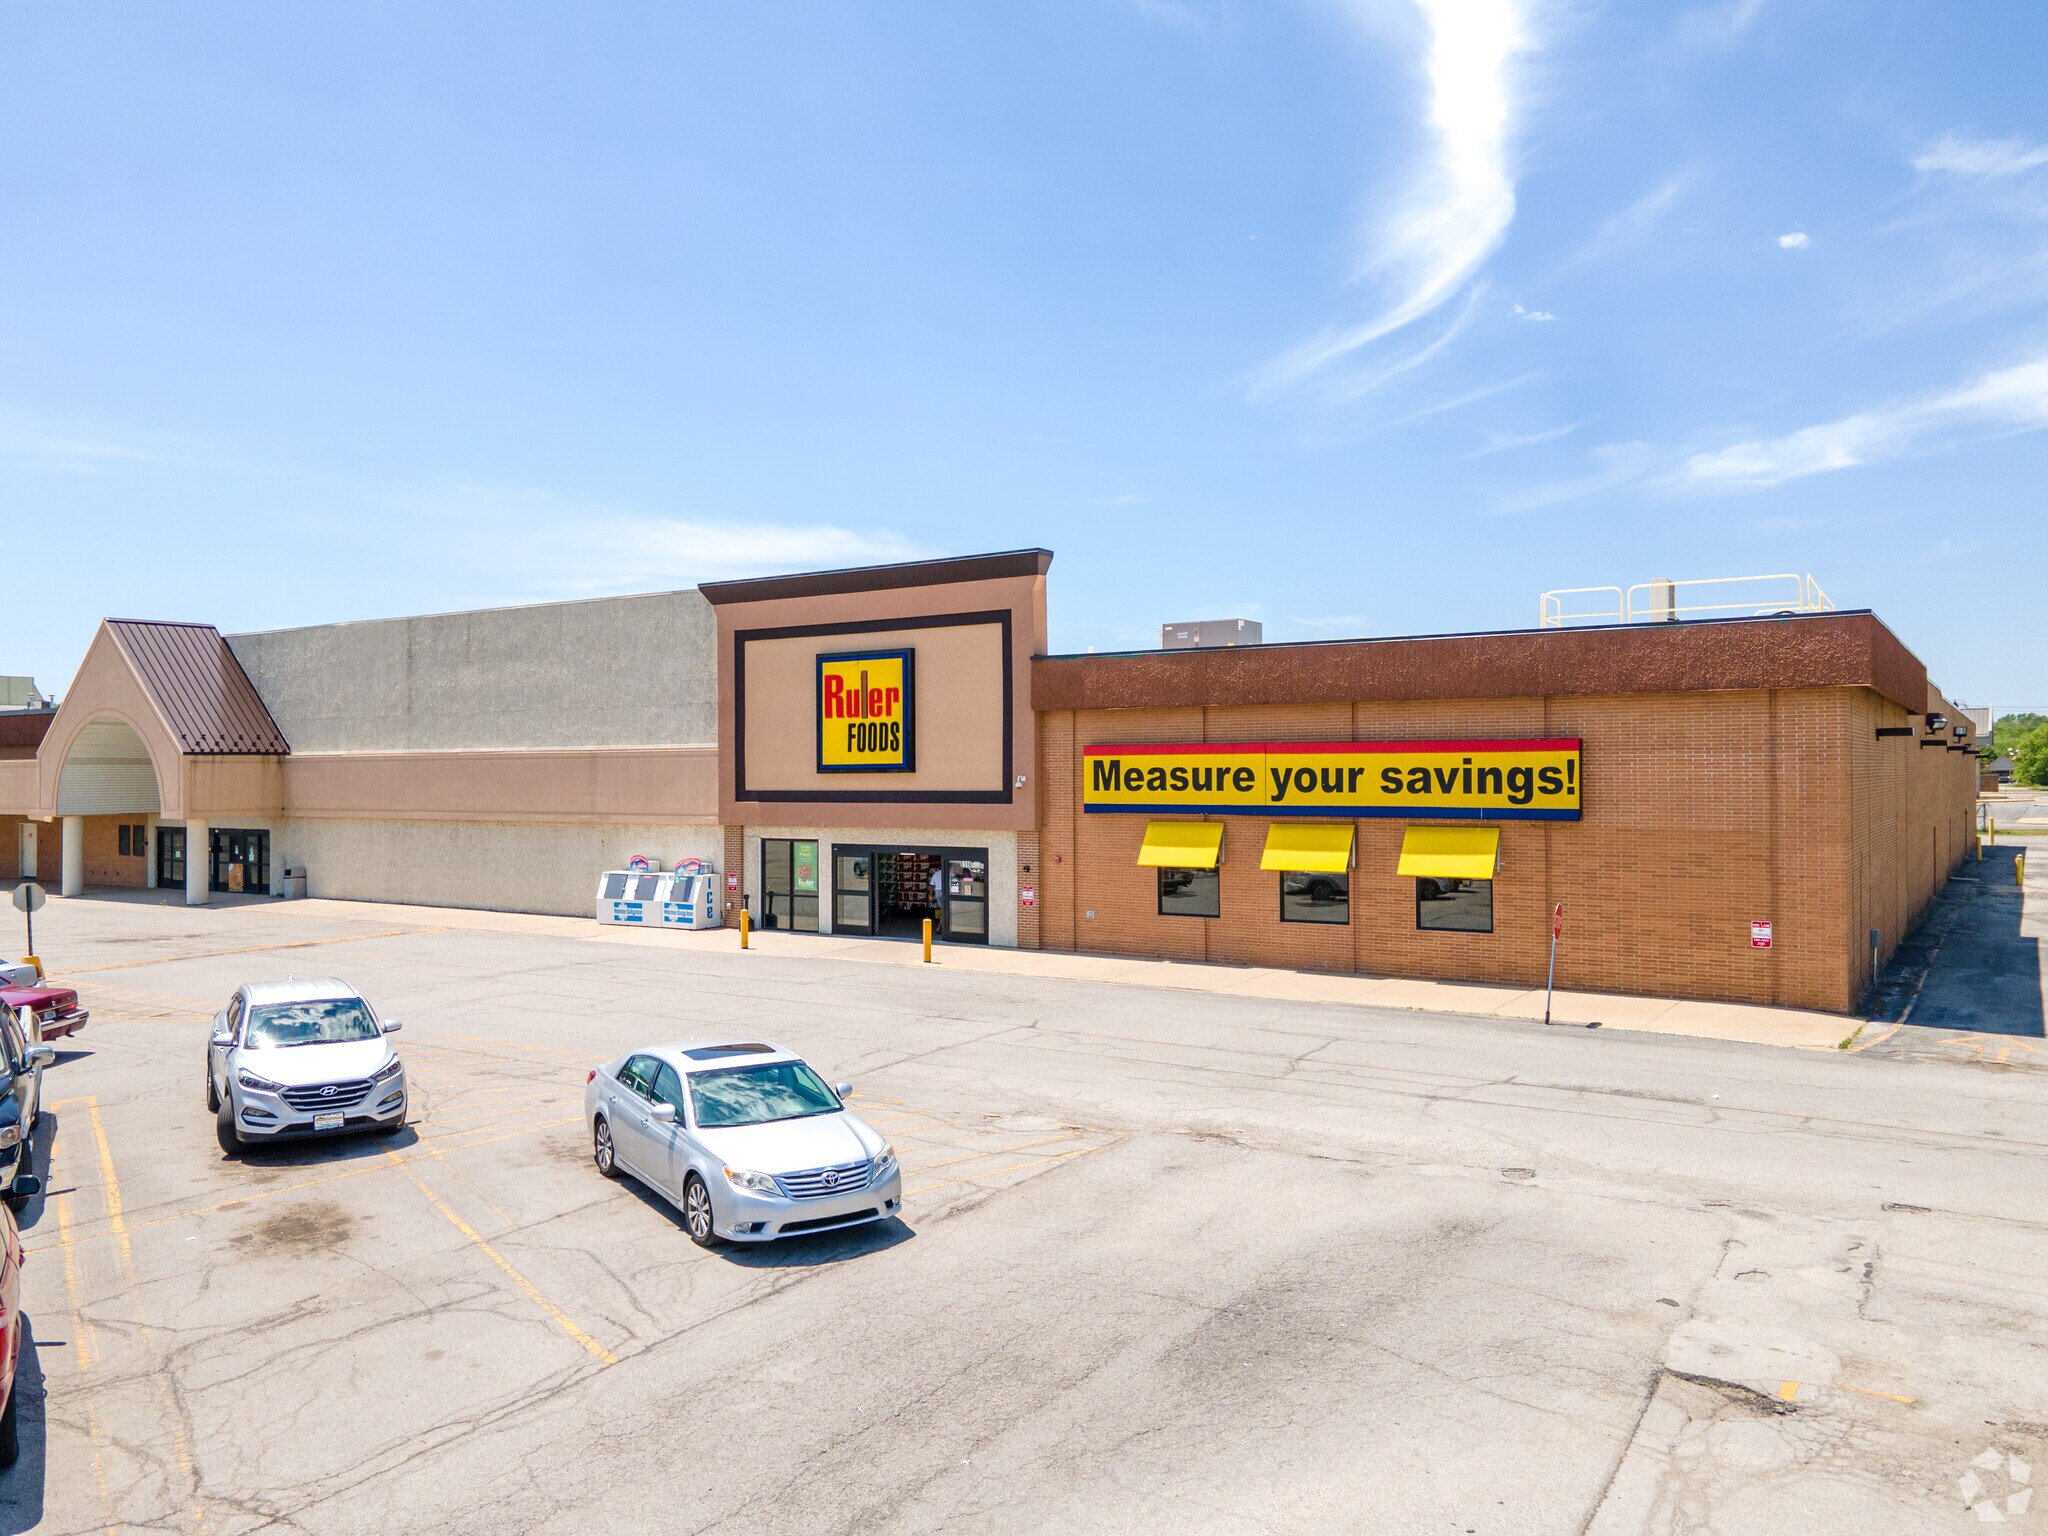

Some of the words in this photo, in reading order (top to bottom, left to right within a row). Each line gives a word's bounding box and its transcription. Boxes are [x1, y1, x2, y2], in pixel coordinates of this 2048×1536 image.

[824, 670, 900, 719] Ruler
[847, 721, 900, 753] FOODS
[1092, 758, 1256, 792] Measure
[1270, 764, 1365, 801] your
[1380, 757, 1577, 805] savings!
